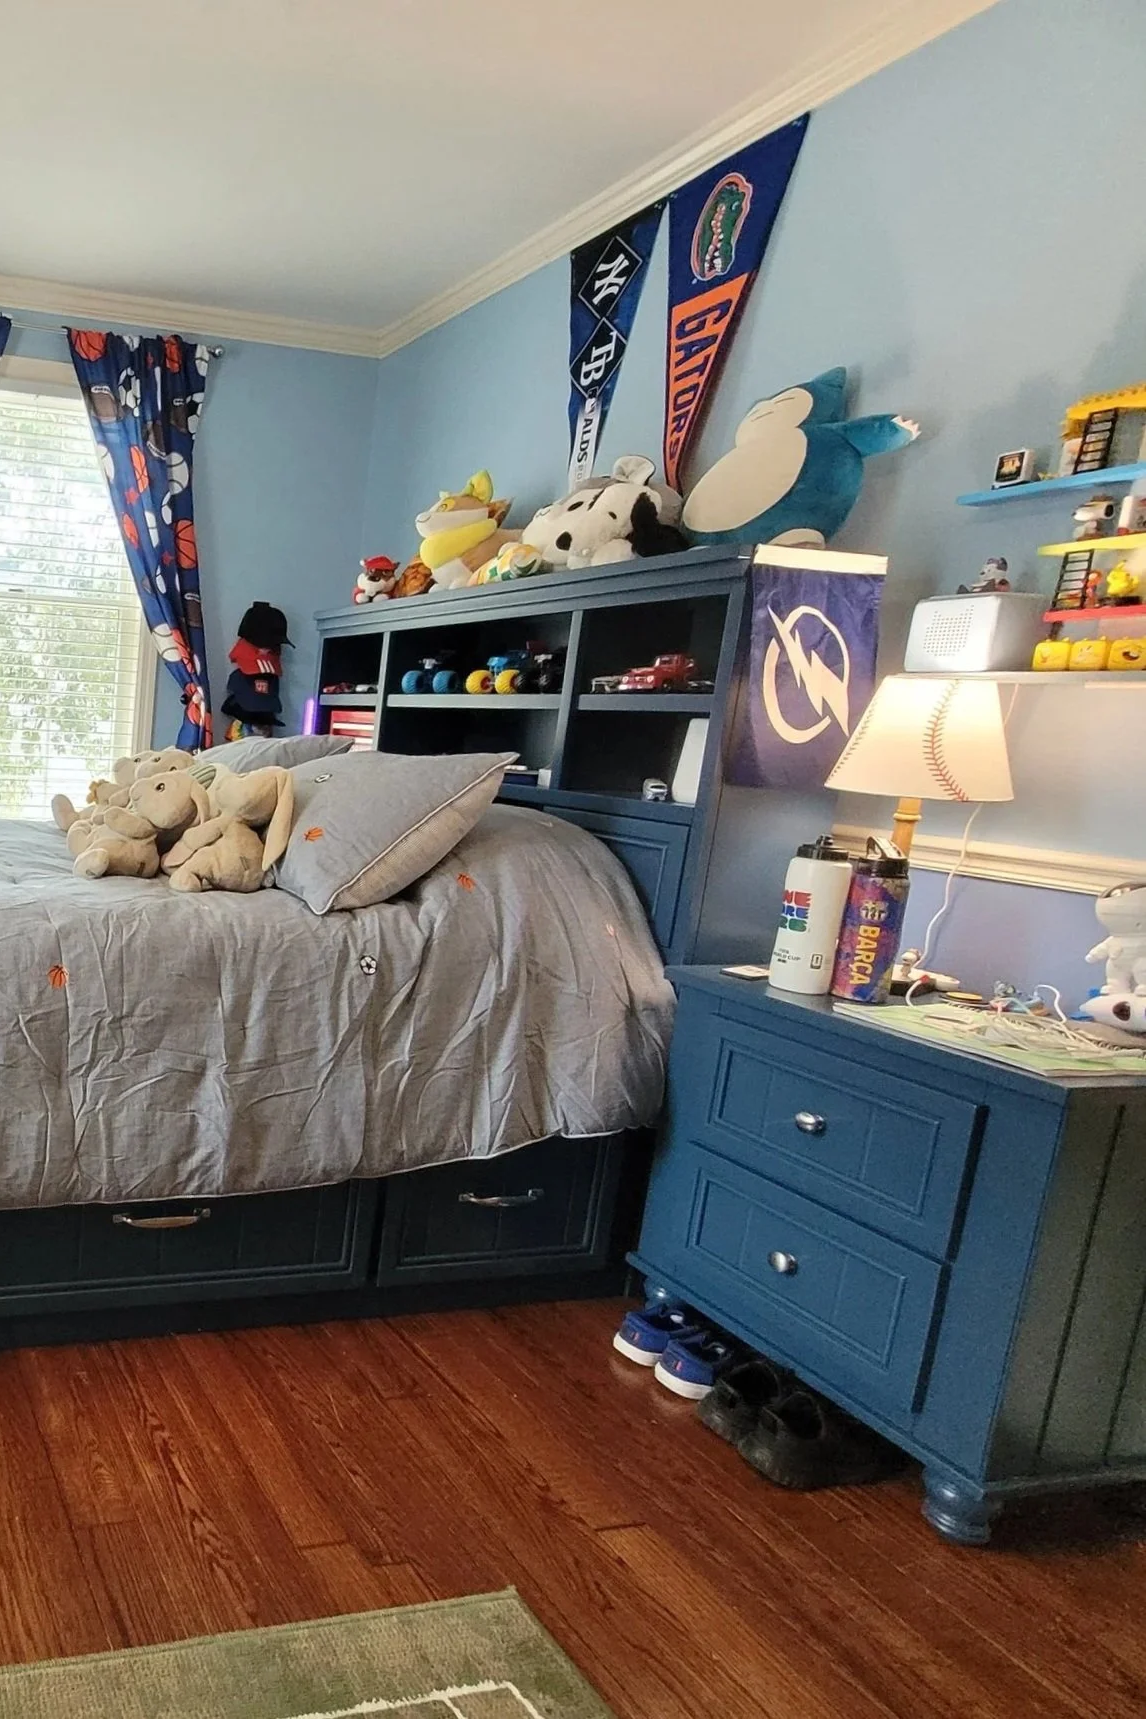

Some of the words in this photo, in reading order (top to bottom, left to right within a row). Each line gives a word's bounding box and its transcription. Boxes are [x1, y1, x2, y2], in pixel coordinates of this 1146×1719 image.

[580, 331, 617, 387] TB
[669, 299, 733, 460] GATORS
[577, 418, 594, 463] ALDS
[848, 925, 881, 985] BARÇA
